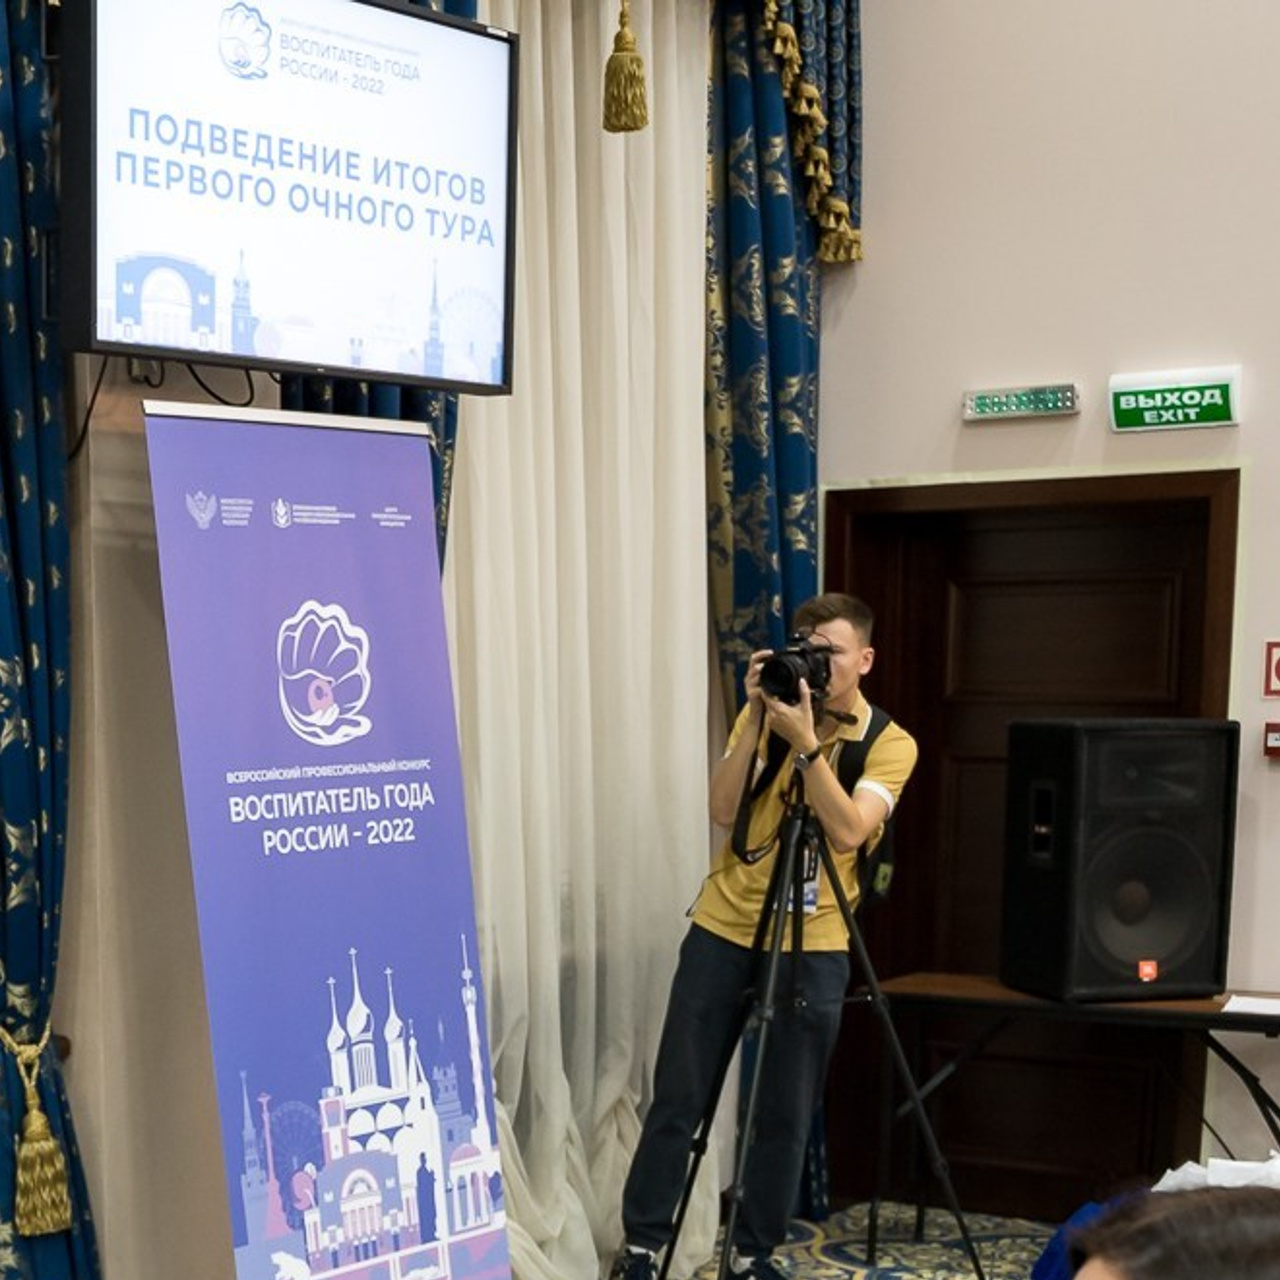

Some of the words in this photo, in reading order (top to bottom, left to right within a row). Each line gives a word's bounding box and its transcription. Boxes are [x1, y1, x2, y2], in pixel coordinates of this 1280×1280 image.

[280, 33, 381, 71] ВОСПИТАТЕЛЬ
[384, 59, 420, 80] ГОДА
[280, 57, 338, 84] РОССИИ
[352, 74, 385, 95] 2022
[129, 108, 360, 181] ПОДВЕДЕНИЕ
[373, 157, 486, 206] ИТОГОВ
[115, 151, 276, 207] ПЕРВОГО
[288, 184, 415, 232] ОЧНОГО
[425, 208, 495, 248] ТУРА
[1119, 389, 1222, 410] ВЫХОД
[1144, 407, 1200, 424] EXIT
[226, 766, 301, 784] ВСЕРОССИЙСКИЙ
[302, 759, 396, 778] ПРОФЕССИОНАЛЬНЫЙ
[397, 759, 431, 771] КОНКУРС
[229, 787, 381, 823] ВОСПИТАТЕЛЬ
[384, 782, 434, 811] ГОДА
[263, 823, 349, 856] РОССИИ
[367, 817, 415, 844] 2022
